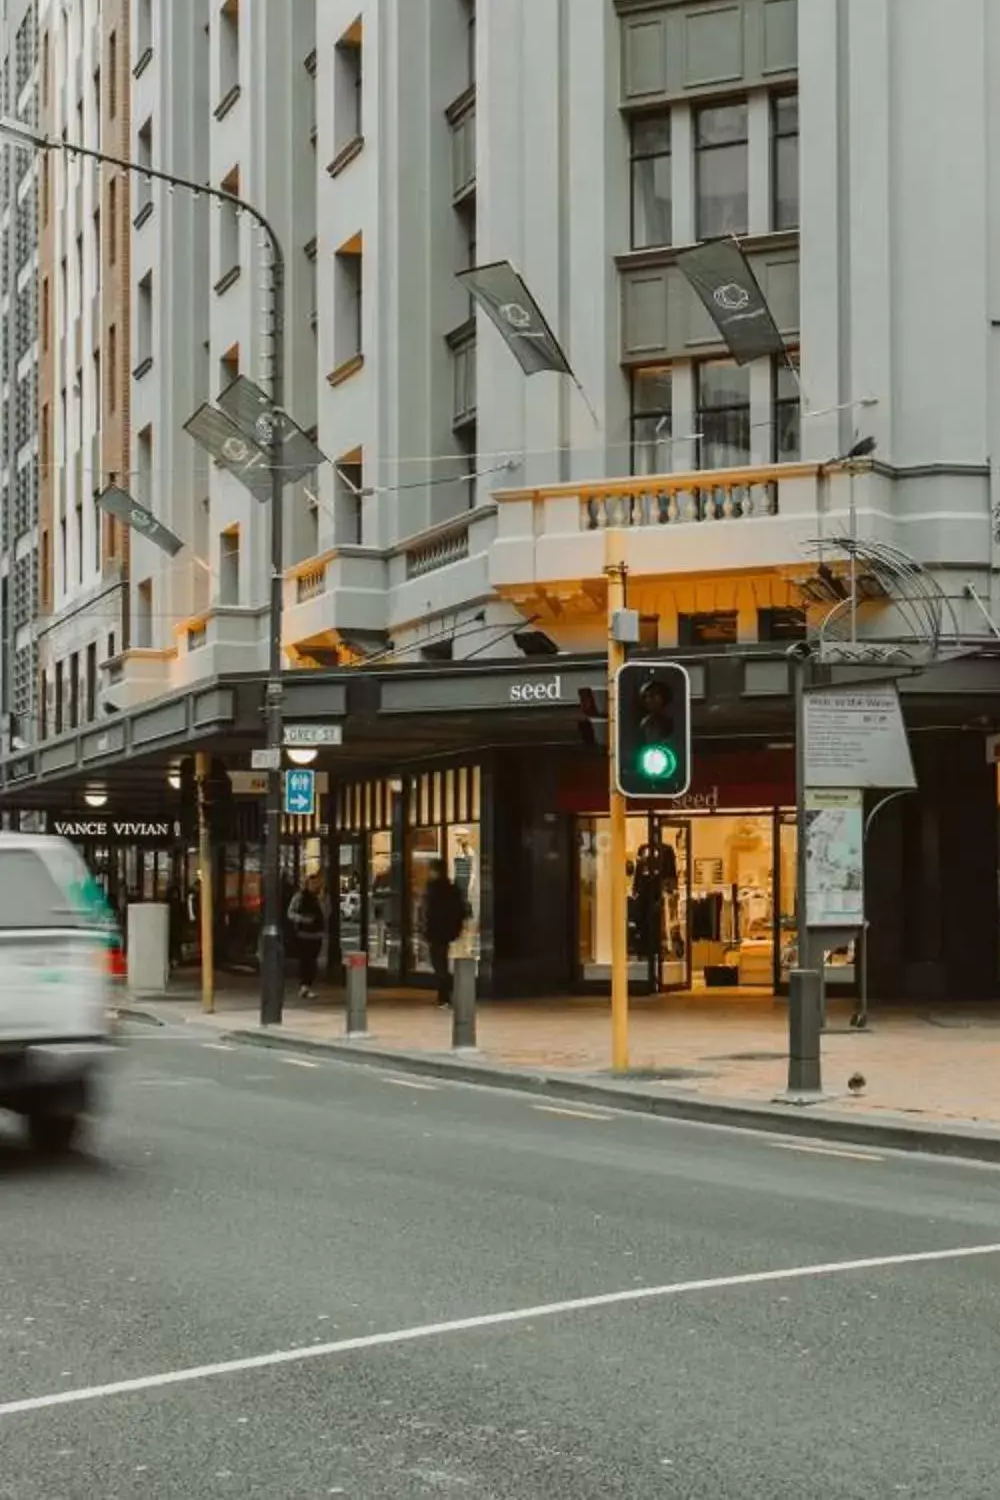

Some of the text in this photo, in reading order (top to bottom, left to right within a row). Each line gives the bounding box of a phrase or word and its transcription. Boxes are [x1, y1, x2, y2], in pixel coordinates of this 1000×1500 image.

[511, 675, 561, 701] seed
[671, 785, 719, 810] seed
[54, 821, 169, 835] VANCE VIVIAN
